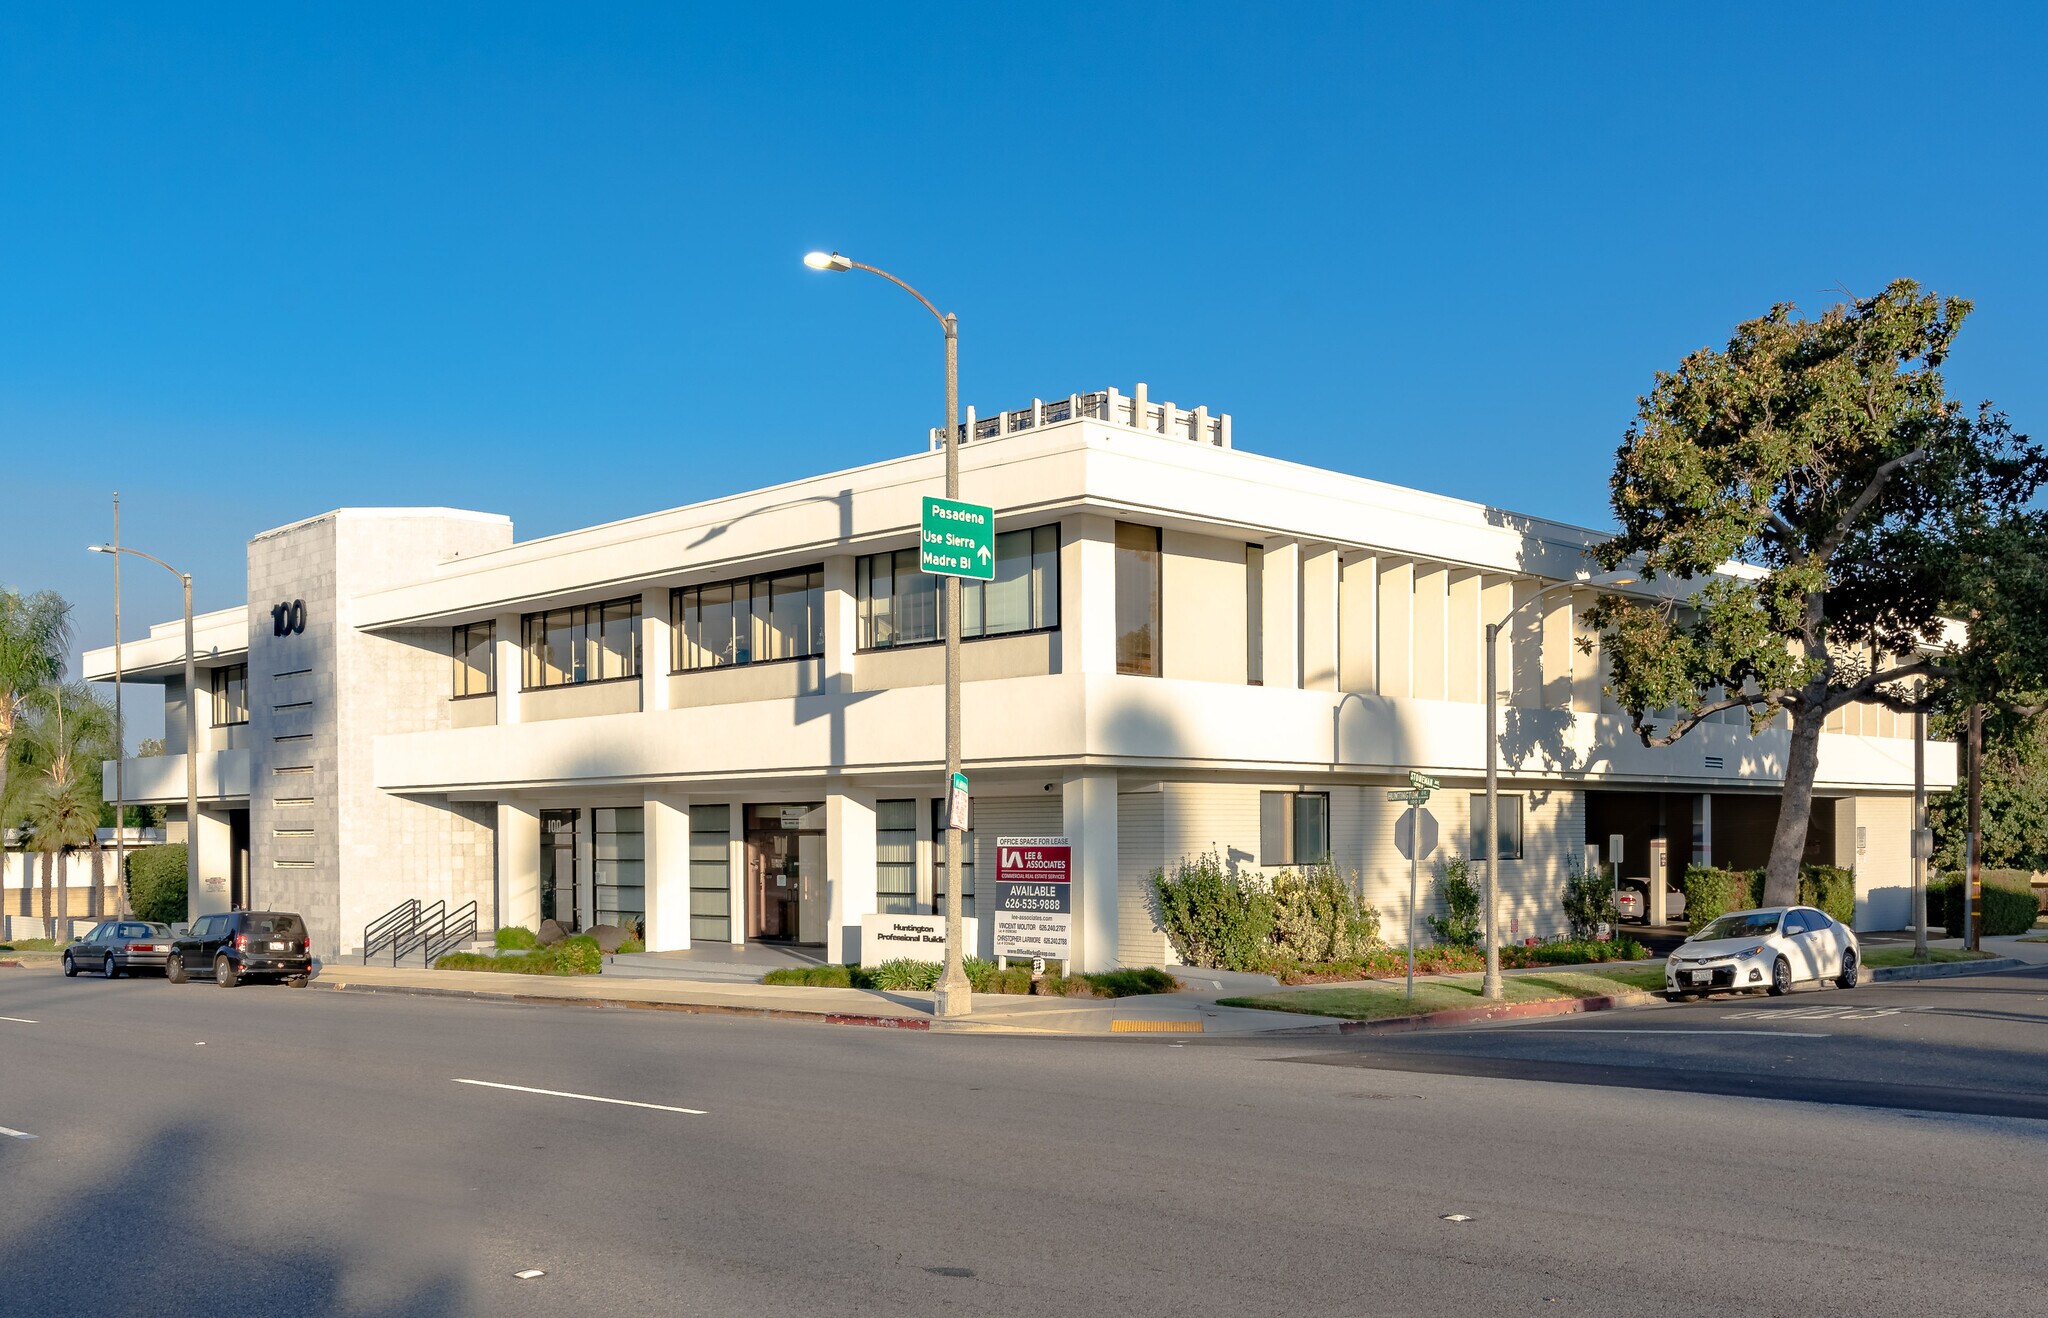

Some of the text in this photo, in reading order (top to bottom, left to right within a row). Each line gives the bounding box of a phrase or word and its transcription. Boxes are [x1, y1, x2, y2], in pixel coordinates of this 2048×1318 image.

[932, 504, 985, 525] Pasadena
[923, 530, 975, 549] Use Sierra
[923, 551, 957, 568] Madre
[270, 598, 308, 638] 100
[1388, 791, 1419, 800] HUNTINGTON
[547, 819, 562, 833] 100
[1024, 851, 1042, 860] LEE &
[1026, 860, 1066, 869] ASSOCIATES
[1010, 885, 1056, 897] AVAILABLE
[1005, 898, 1060, 910] 626-535-9888
[893, 923, 934, 933] Huntington
[877, 933, 946, 943] Professional Buildin
